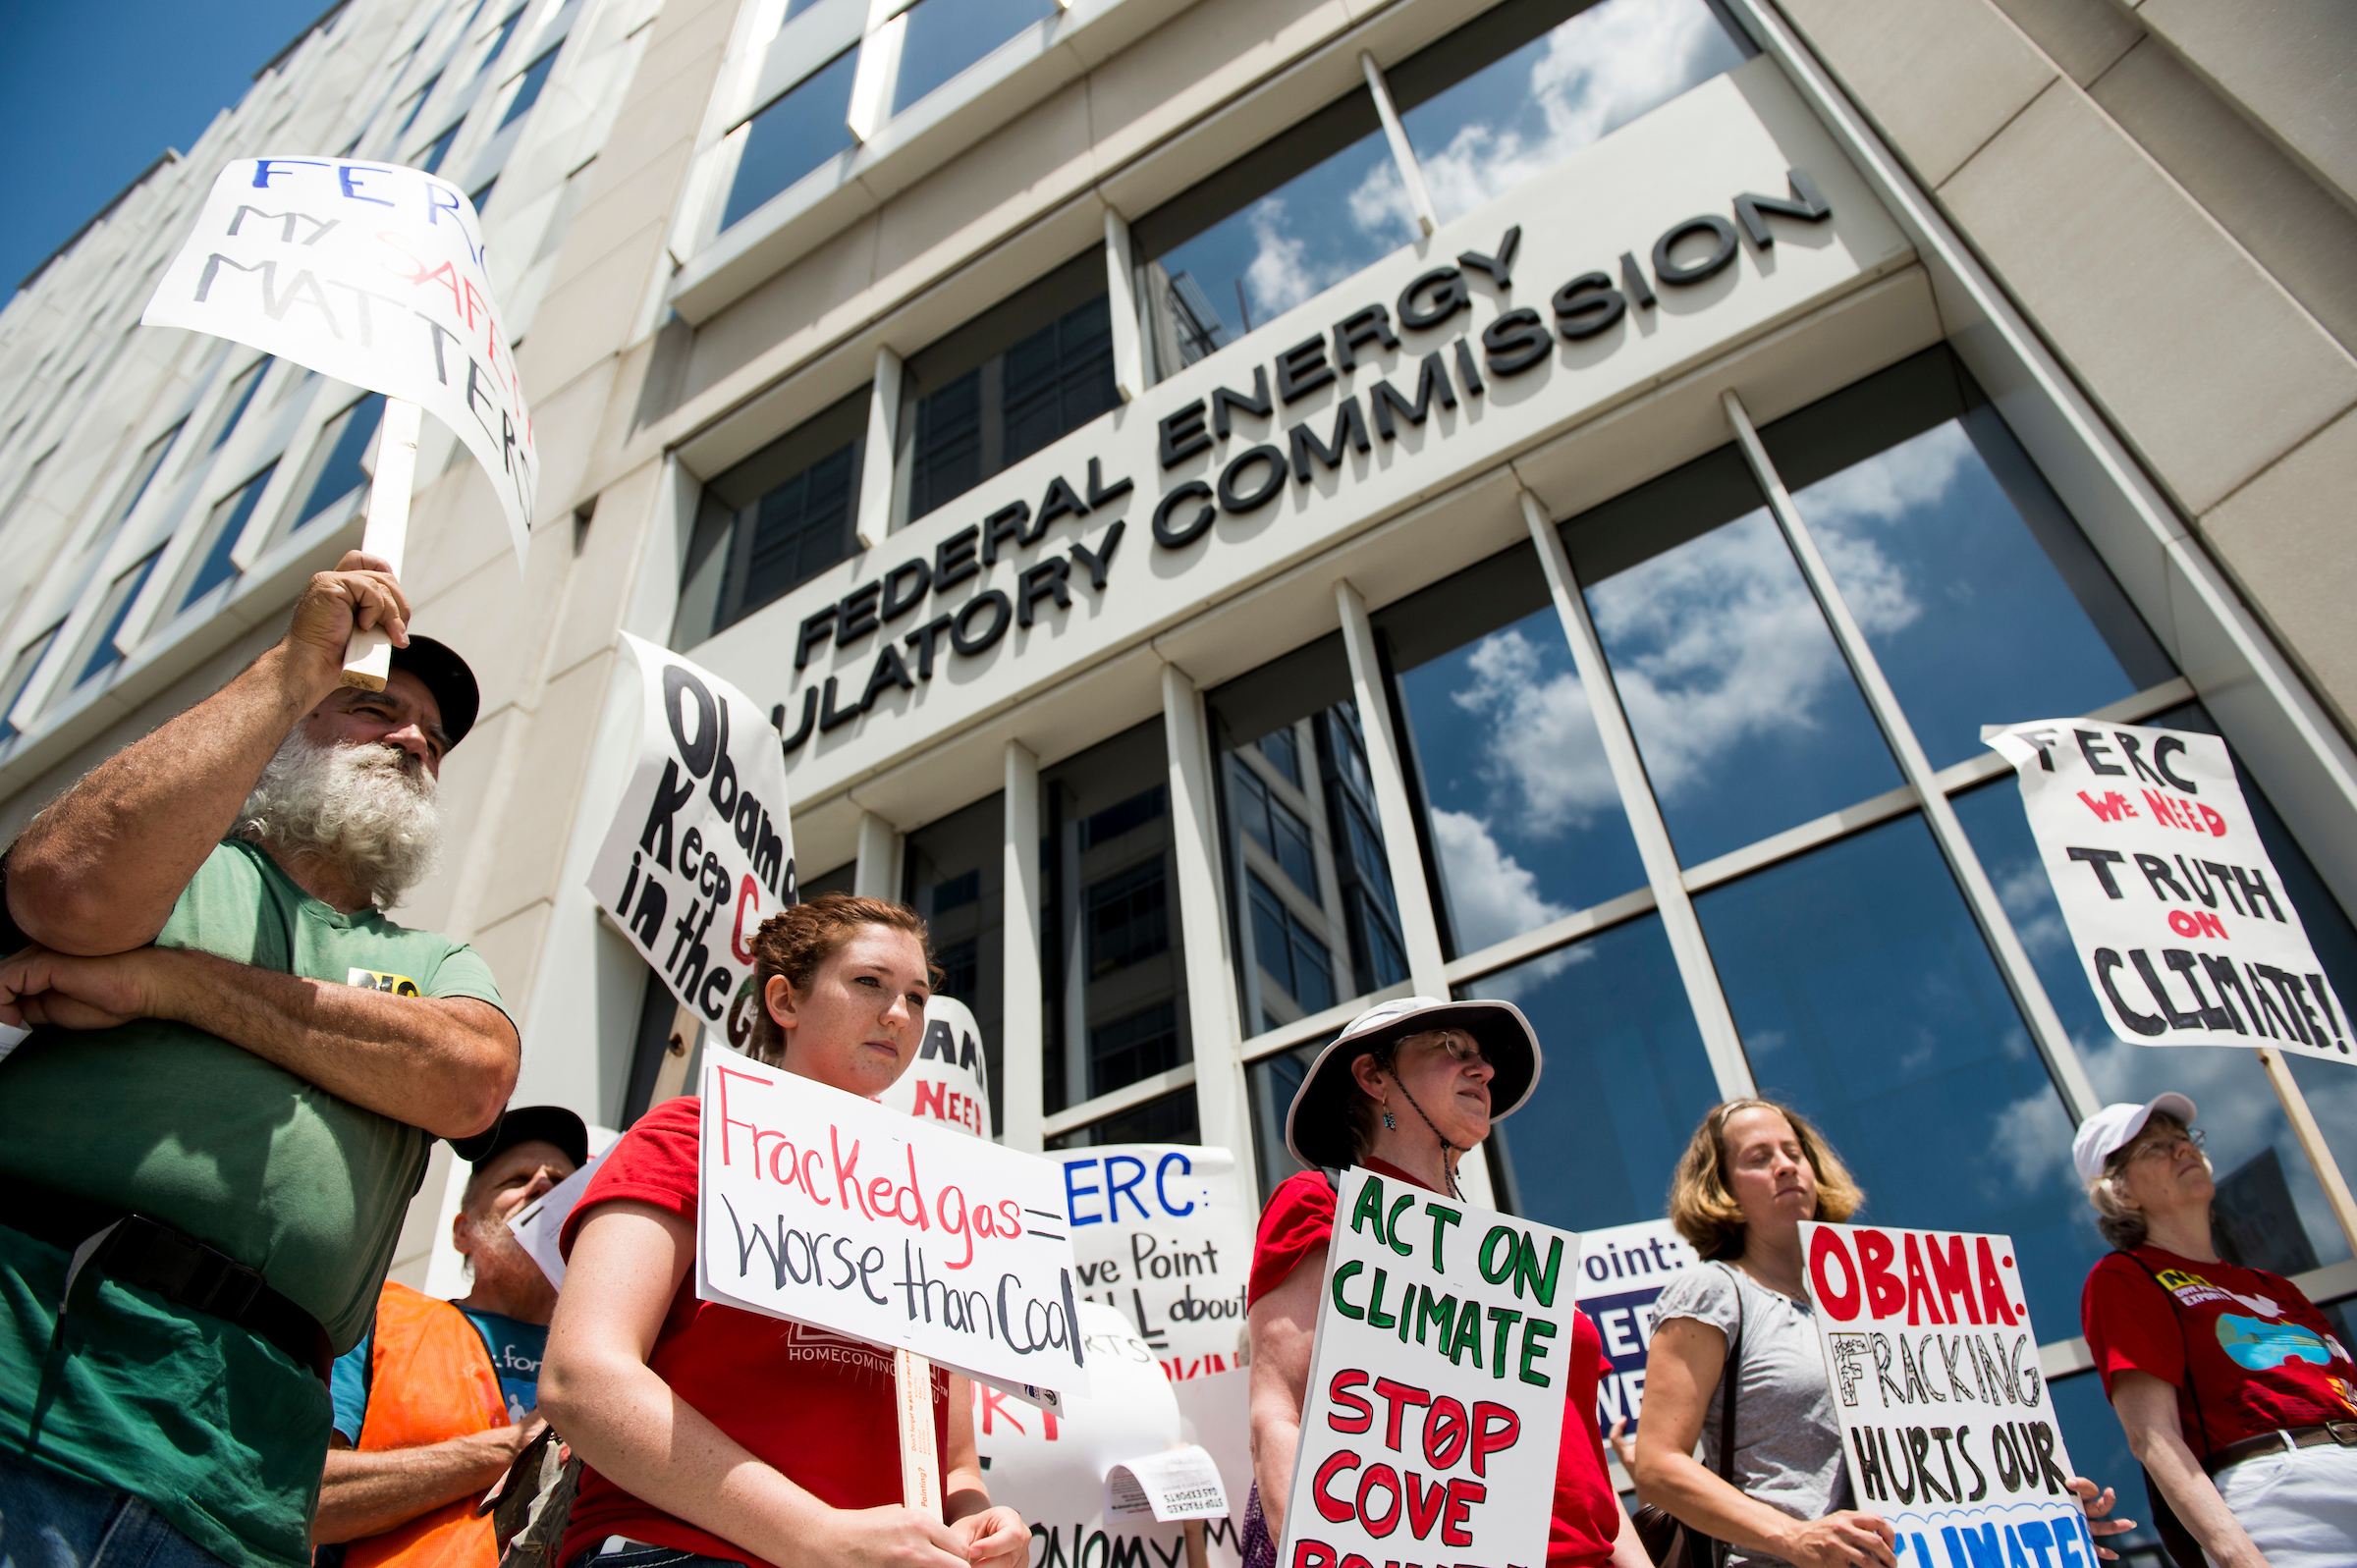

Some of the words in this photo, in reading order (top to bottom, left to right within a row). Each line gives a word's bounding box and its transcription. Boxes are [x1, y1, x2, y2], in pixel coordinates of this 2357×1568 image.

[226, 205, 342, 246] MY
[1151, 169, 1832, 549] COMMISSION
[795, 456, 1133, 671] FEDERAL
[1158, 225, 1521, 469] ENERGY
[2013, 728, 2198, 794] FERC
[639, 757, 731, 926] Keep
[2077, 790, 2139, 823] WE
[2141, 788, 2227, 838] NEED
[2066, 846, 2288, 924] TRUTH
[2167, 909, 2229, 940] ON
[615, 850, 668, 951] in
[665, 898, 733, 1021] the
[2094, 947, 2350, 1054] CLIMATE!
[716, 1064, 929, 1231] Fracked
[1076, 1259, 1122, 1287] ve
[1131, 1232, 1218, 1280] Point
[1350, 1175, 1462, 1273] ACT
[1478, 1224, 1563, 1308] ON
[1578, 1237, 1684, 1282] oint:
[1809, 1225, 2026, 1326] OBAMA:
[893, 1238, 994, 1340] than
[996, 1267, 1084, 1369] Coal
[1332, 1260, 1558, 1388] CLIMATE
[1829, 1332, 2041, 1408] FRACKING
[1328, 1369, 1521, 1478] STOP
[1851, 1425, 1987, 1505] HURTS
[1993, 1421, 2080, 1496] OUR
[918, 1467, 928, 1507] Painting?
[1313, 1449, 1487, 1547] COVE
